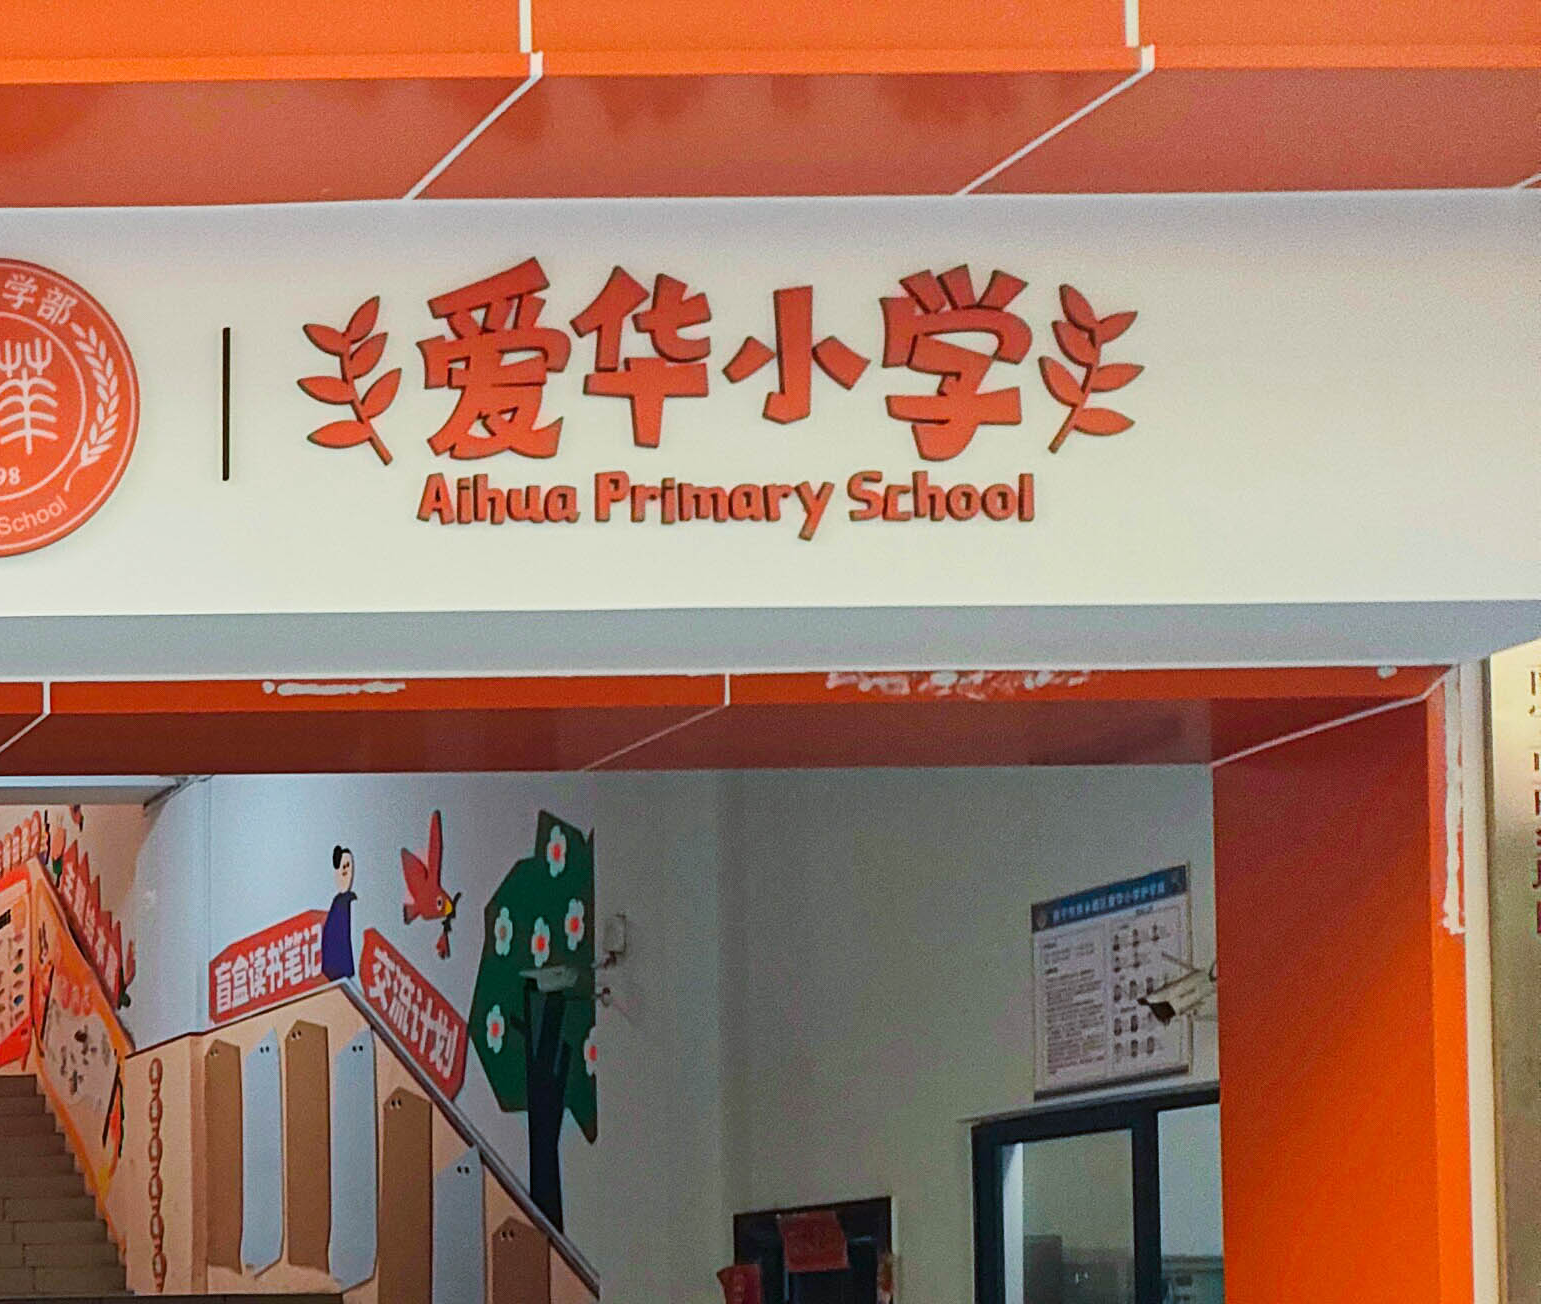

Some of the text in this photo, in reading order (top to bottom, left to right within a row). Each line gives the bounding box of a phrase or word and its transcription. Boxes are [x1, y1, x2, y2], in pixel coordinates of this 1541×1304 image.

[417, 257, 1032, 461] 爱华小学
[416, 470, 1034, 541] Aihua Primary School
[215, 923, 323, 1013] 盲盒读书笔记
[371, 945, 460, 1079] 交流计划
